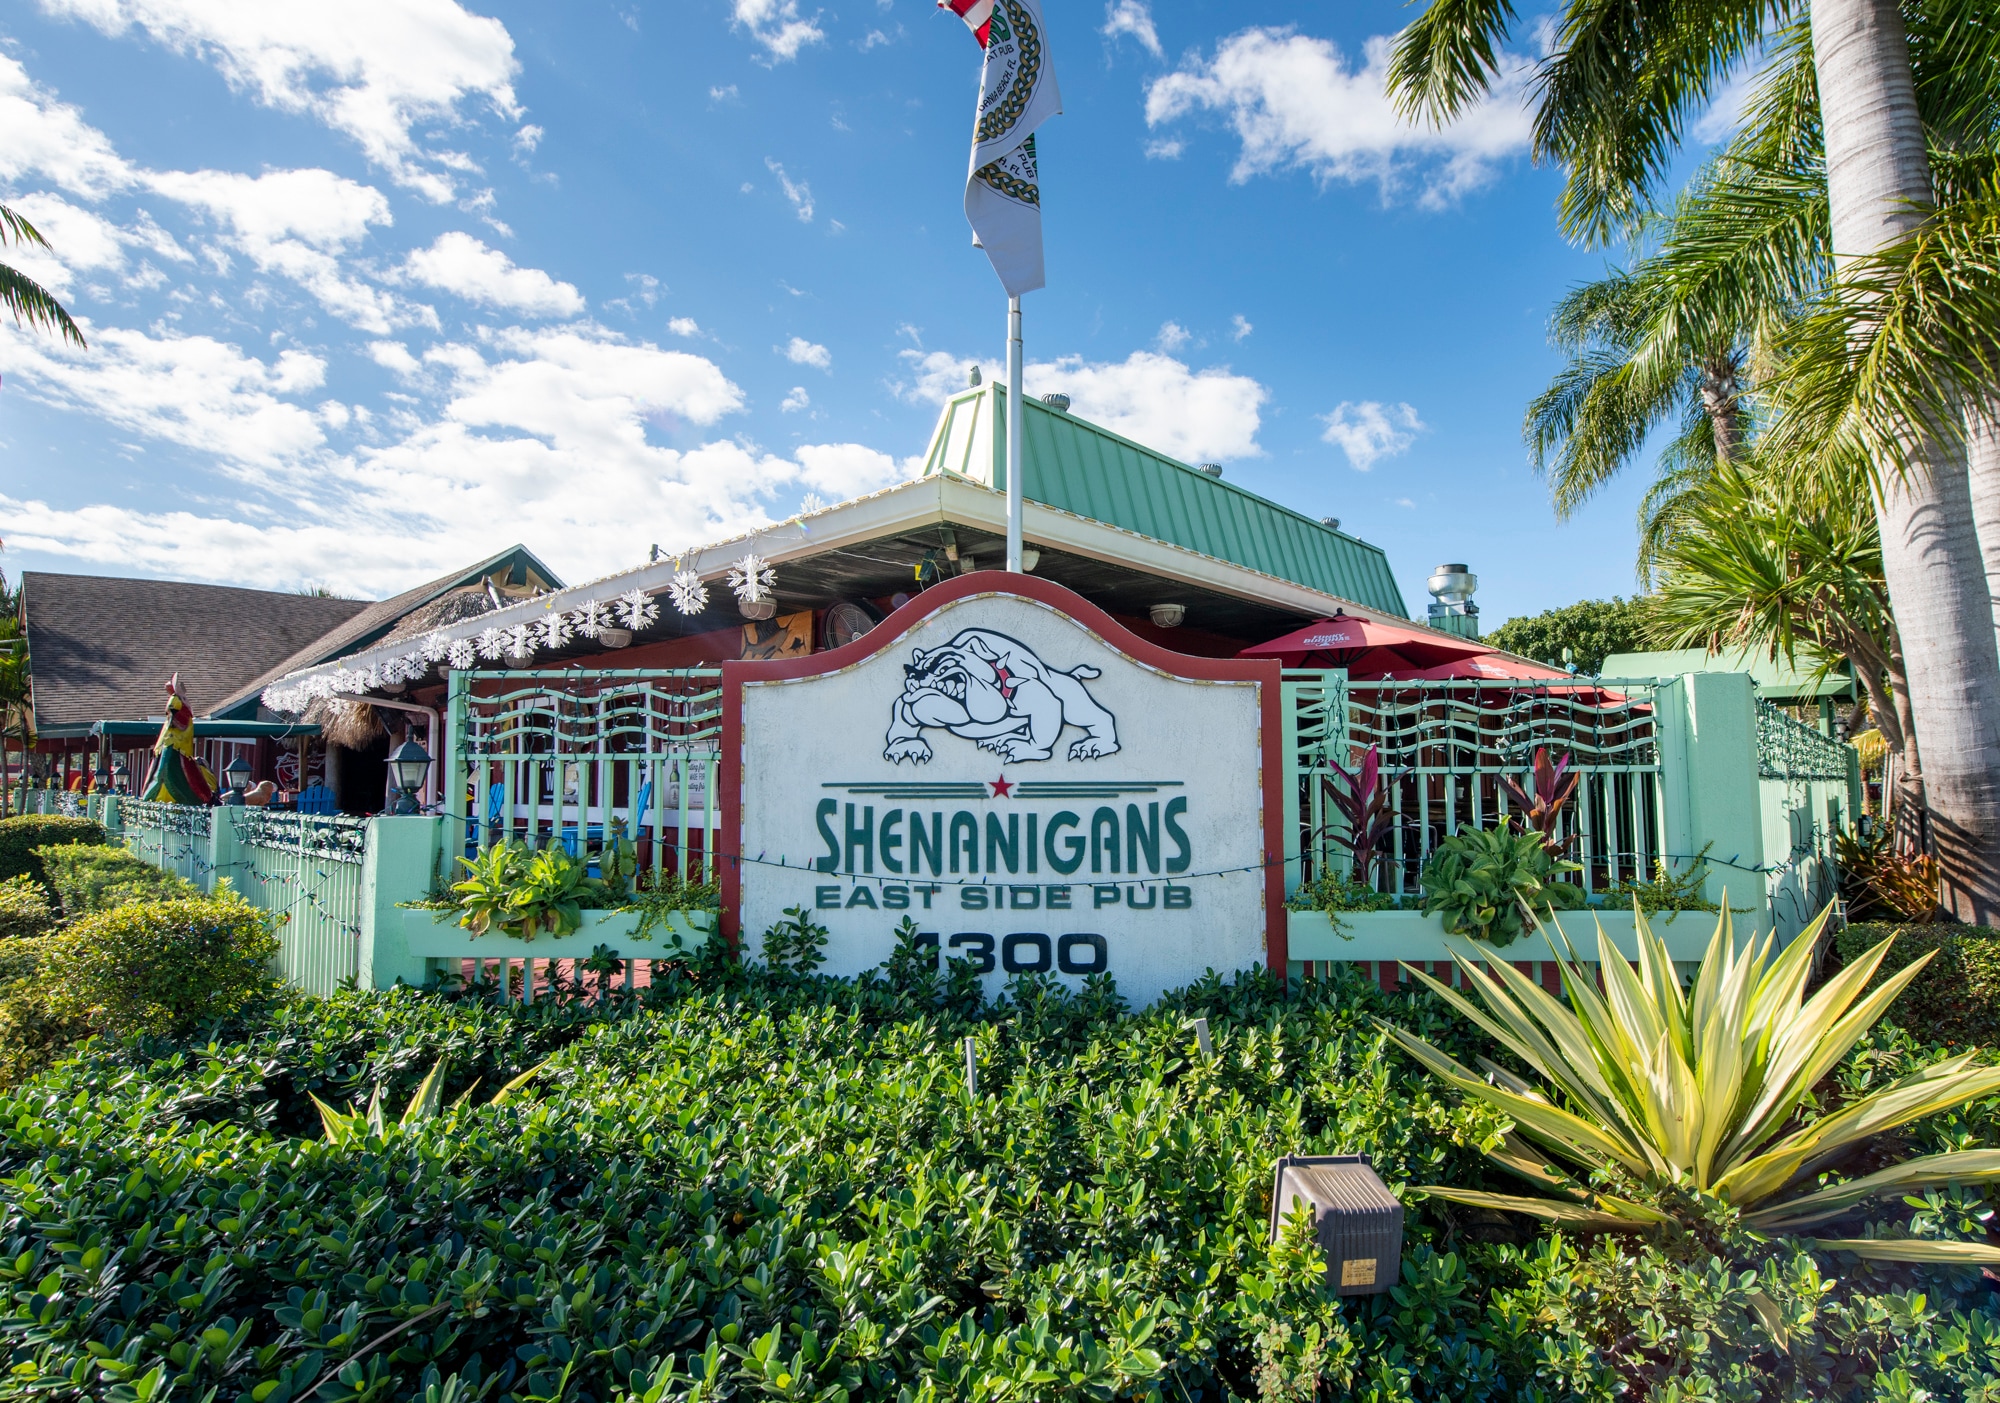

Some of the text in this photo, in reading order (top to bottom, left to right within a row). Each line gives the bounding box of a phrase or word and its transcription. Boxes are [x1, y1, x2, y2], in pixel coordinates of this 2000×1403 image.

[998, 44, 1014, 57] PUB
[1007, 58, 1017, 70] FL
[1010, 164, 1020, 176] FL
[1018, 153, 1034, 178] PUB
[816, 796, 1192, 876] SHENANIGANS
[816, 885, 1192, 910] EAST SIDE PUB
[914, 933, 1107, 974] 1300
